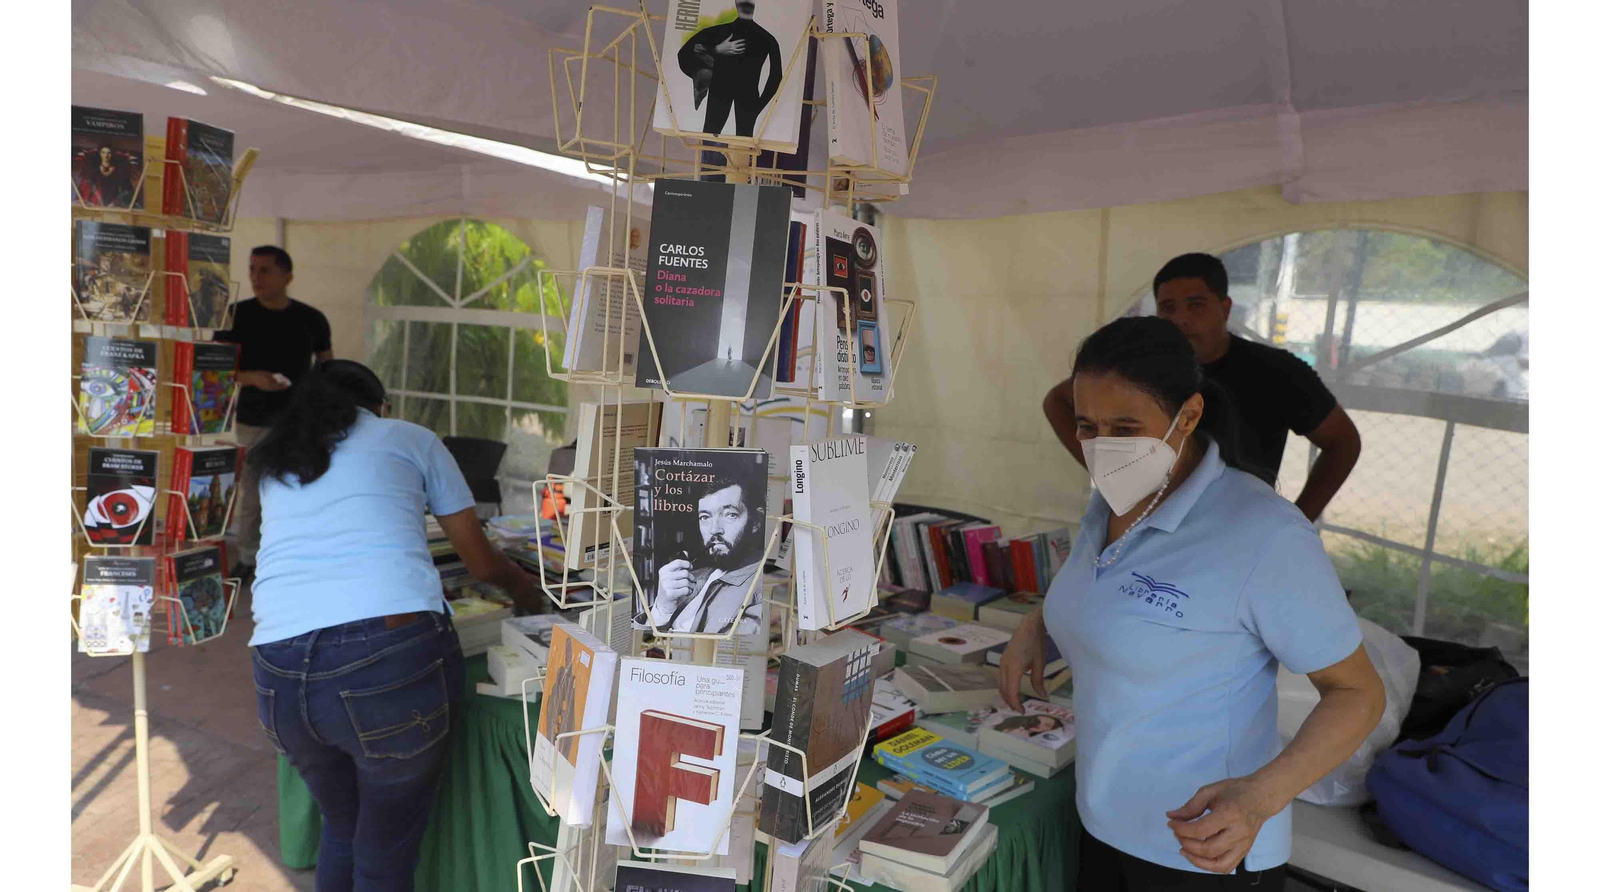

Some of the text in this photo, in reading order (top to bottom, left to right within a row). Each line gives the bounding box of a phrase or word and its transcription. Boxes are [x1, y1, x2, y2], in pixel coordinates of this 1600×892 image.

[675, 0, 700, 31] HERM
[858, 0, 884, 19] tega
[86, 120, 125, 130] VAMPIROS
[660, 243, 705, 256] CARLOS
[658, 256, 708, 269] FUENTES
[657, 270, 686, 282] Diana
[656, 284, 722, 297] o la cazadora
[654, 296, 695, 307] solitaria
[836, 335, 854, 352] Pensr
[811, 438, 864, 462] SUBLIME
[654, 458, 712, 468] Jesús Marchamalo
[888, 455, 903, 482] Monterroso
[654, 468, 716, 484] Cortázar
[795, 460, 806, 494] Longino
[654, 484, 682, 496] y los
[654, 499, 693, 512] libros
[836, 565, 854, 580] ACERCA
[839, 575, 846, 584] DE
[630, 667, 686, 686] Filosofía
[696, 675, 709, 684] Una
[696, 682, 710, 690] para
[696, 690, 736, 698] principiantes
[888, 732, 919, 746] DANIEL
[893, 734, 934, 754] GOLEMAN
